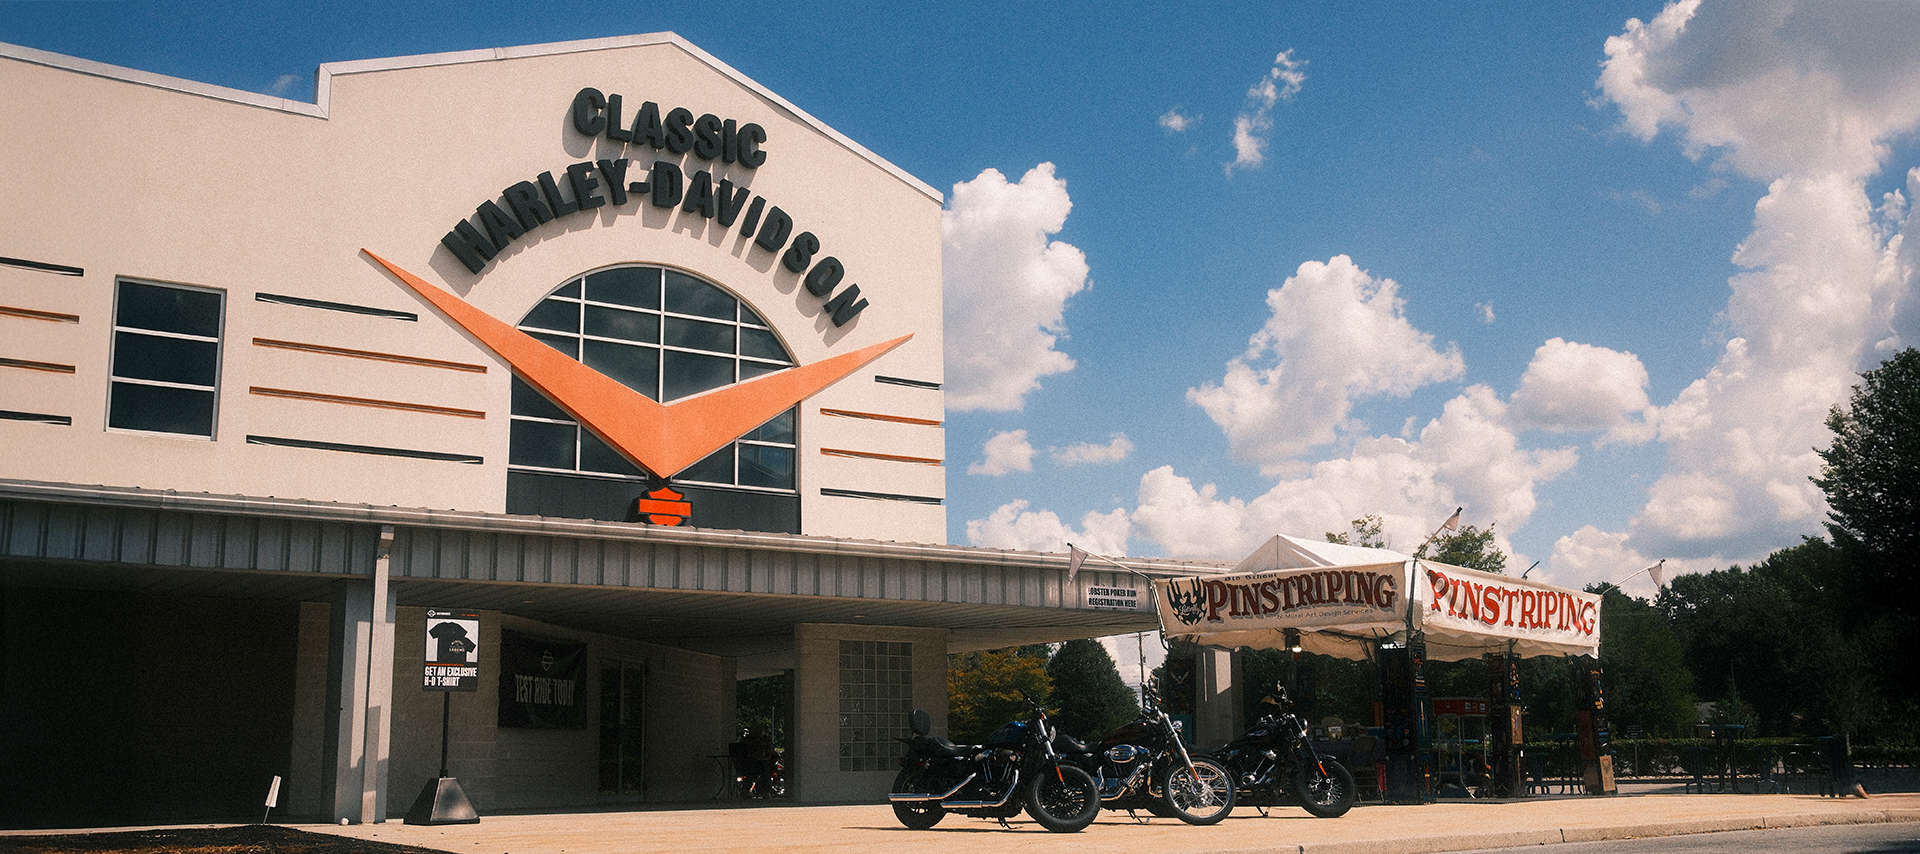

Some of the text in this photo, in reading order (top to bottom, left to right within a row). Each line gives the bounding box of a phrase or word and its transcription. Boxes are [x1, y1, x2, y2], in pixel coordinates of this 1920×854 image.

[573, 87, 767, 169] CLASSIC
[441, 158, 869, 328] HARLEY-DAVIDSON
[1089, 597, 1137, 608] REGISTRATION HERE
[1110, 588, 1126, 597] POKER
[1127, 589, 1137, 597] RUN
[1203, 570, 1397, 622] PINSTRIPING
[1427, 569, 1597, 636] PINSTRIPING
[424, 666, 477, 677] GET AN EXCLUSIVE
[424, 676, 460, 687] H-D T-SHIRT
[514, 674, 576, 706] TEST RIDE TODAY
